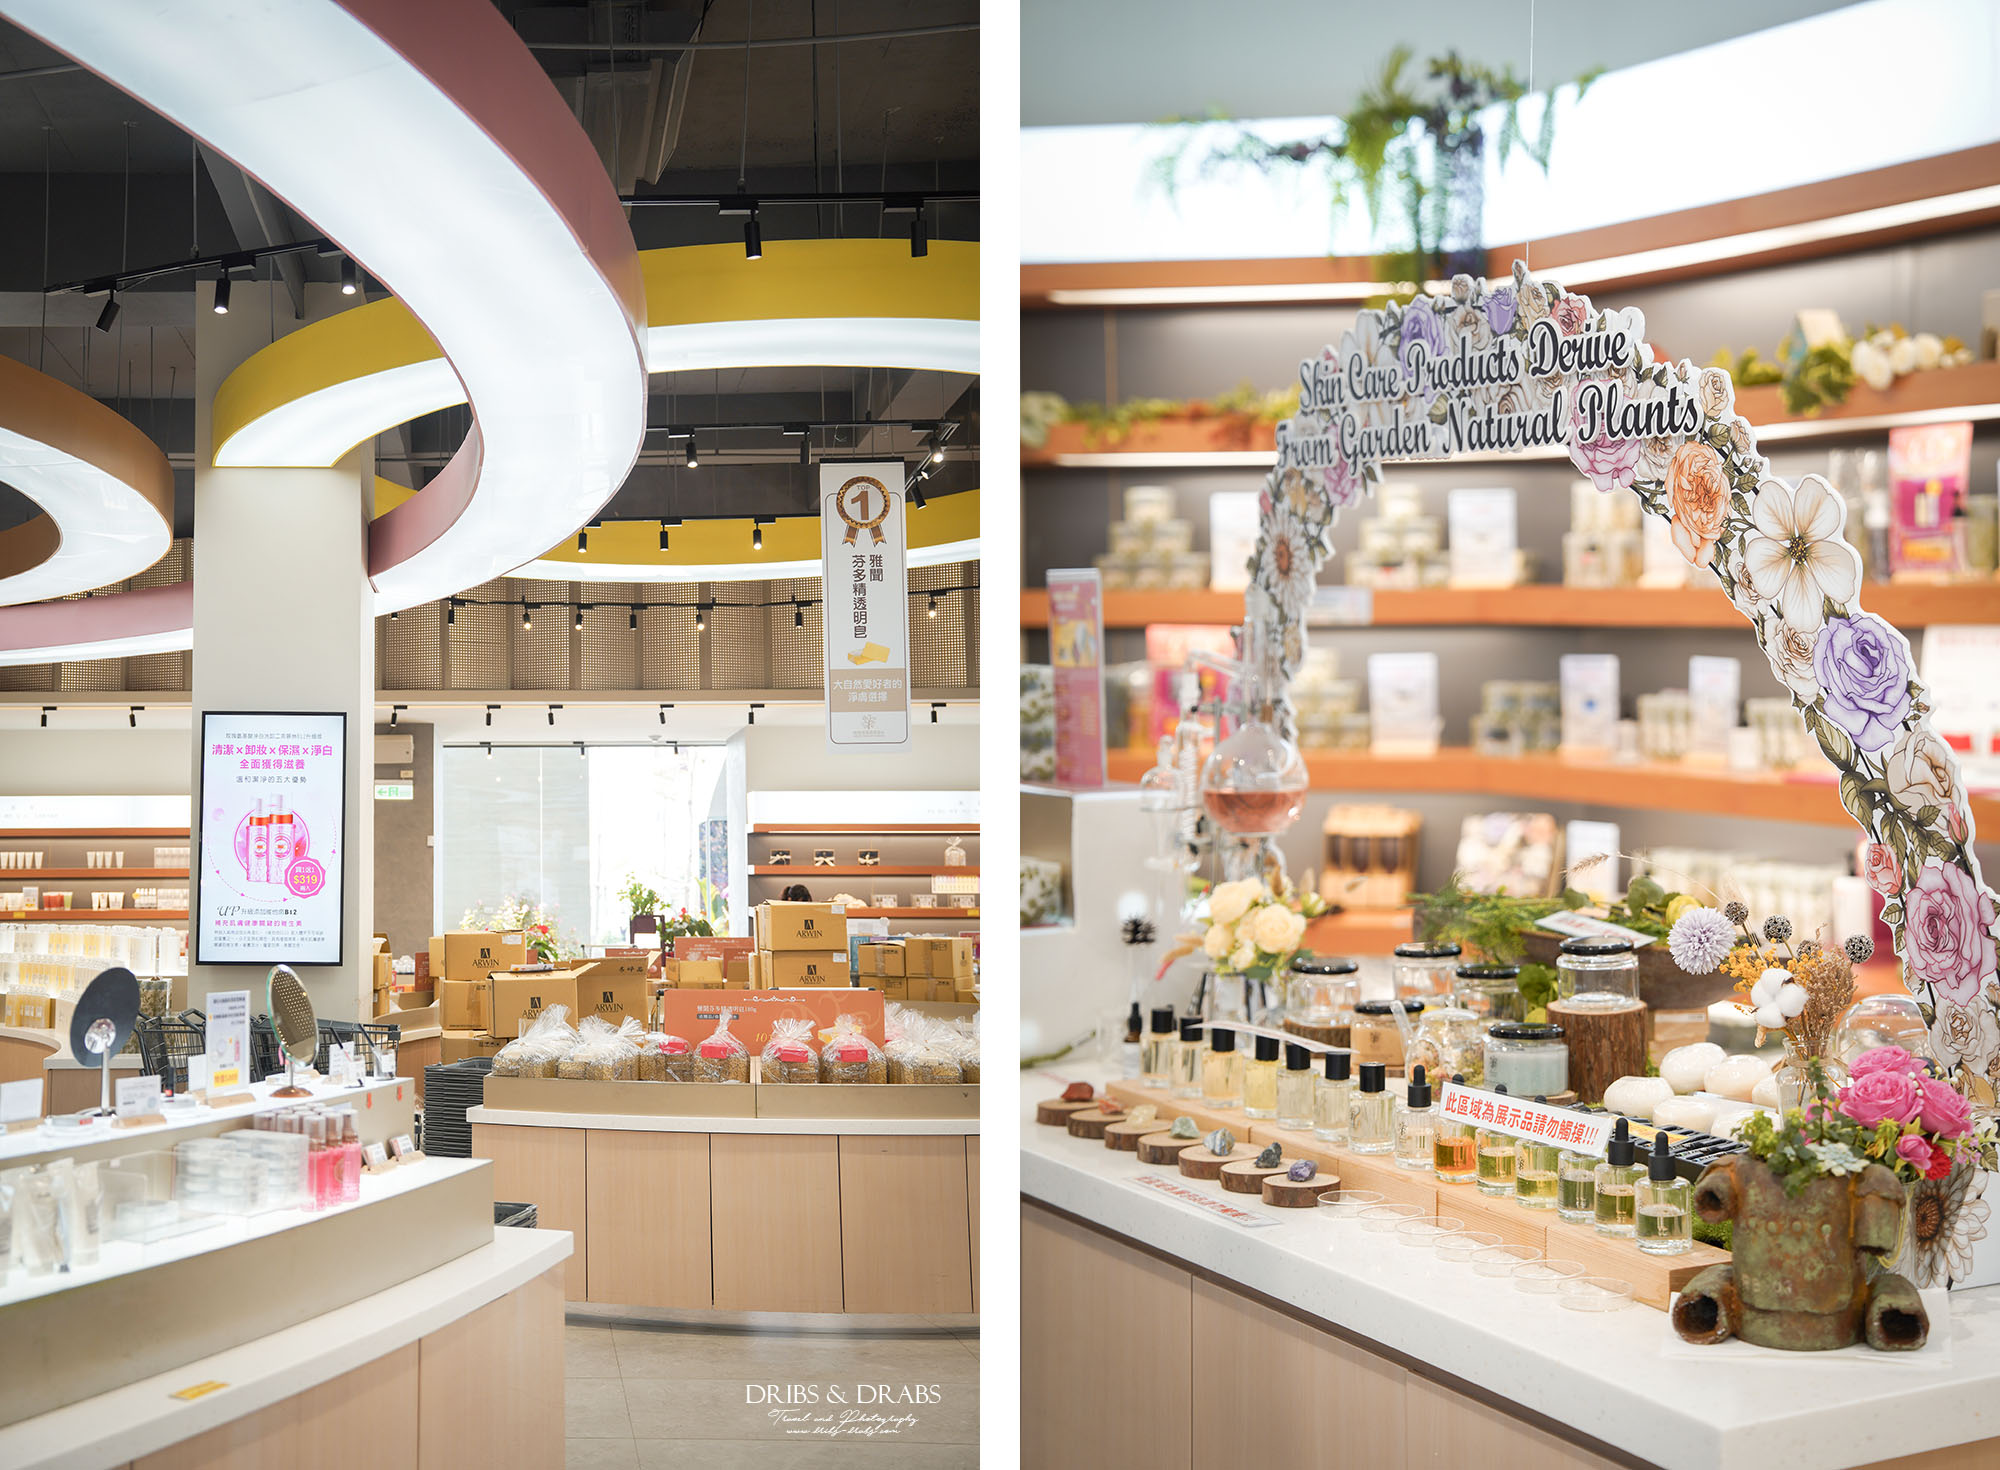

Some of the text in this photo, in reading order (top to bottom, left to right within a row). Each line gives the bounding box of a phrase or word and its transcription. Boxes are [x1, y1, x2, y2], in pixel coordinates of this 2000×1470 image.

[1299, 320, 1630, 409] Skin Care Products Derive
[1277, 385, 1700, 478] From Garden Natural Plants
[851, 490, 869, 521] 1
[869, 554, 884, 582] 雅聞
[852, 554, 868, 639] 芬多精透明皂
[833, 679, 902, 690] 大自然愛好者的
[239, 759, 305, 770] 全面獲得滋養
[293, 874, 318, 884] $319
[796, 929, 823, 937] ARWIN
[472, 959, 499, 967] ARWIN
[798, 975, 826, 983] ARWIN
[594, 1003, 624, 1011] ARWIN
[1445, 1091, 1599, 1146] 此區域為展示品請勿觸摸!!!
